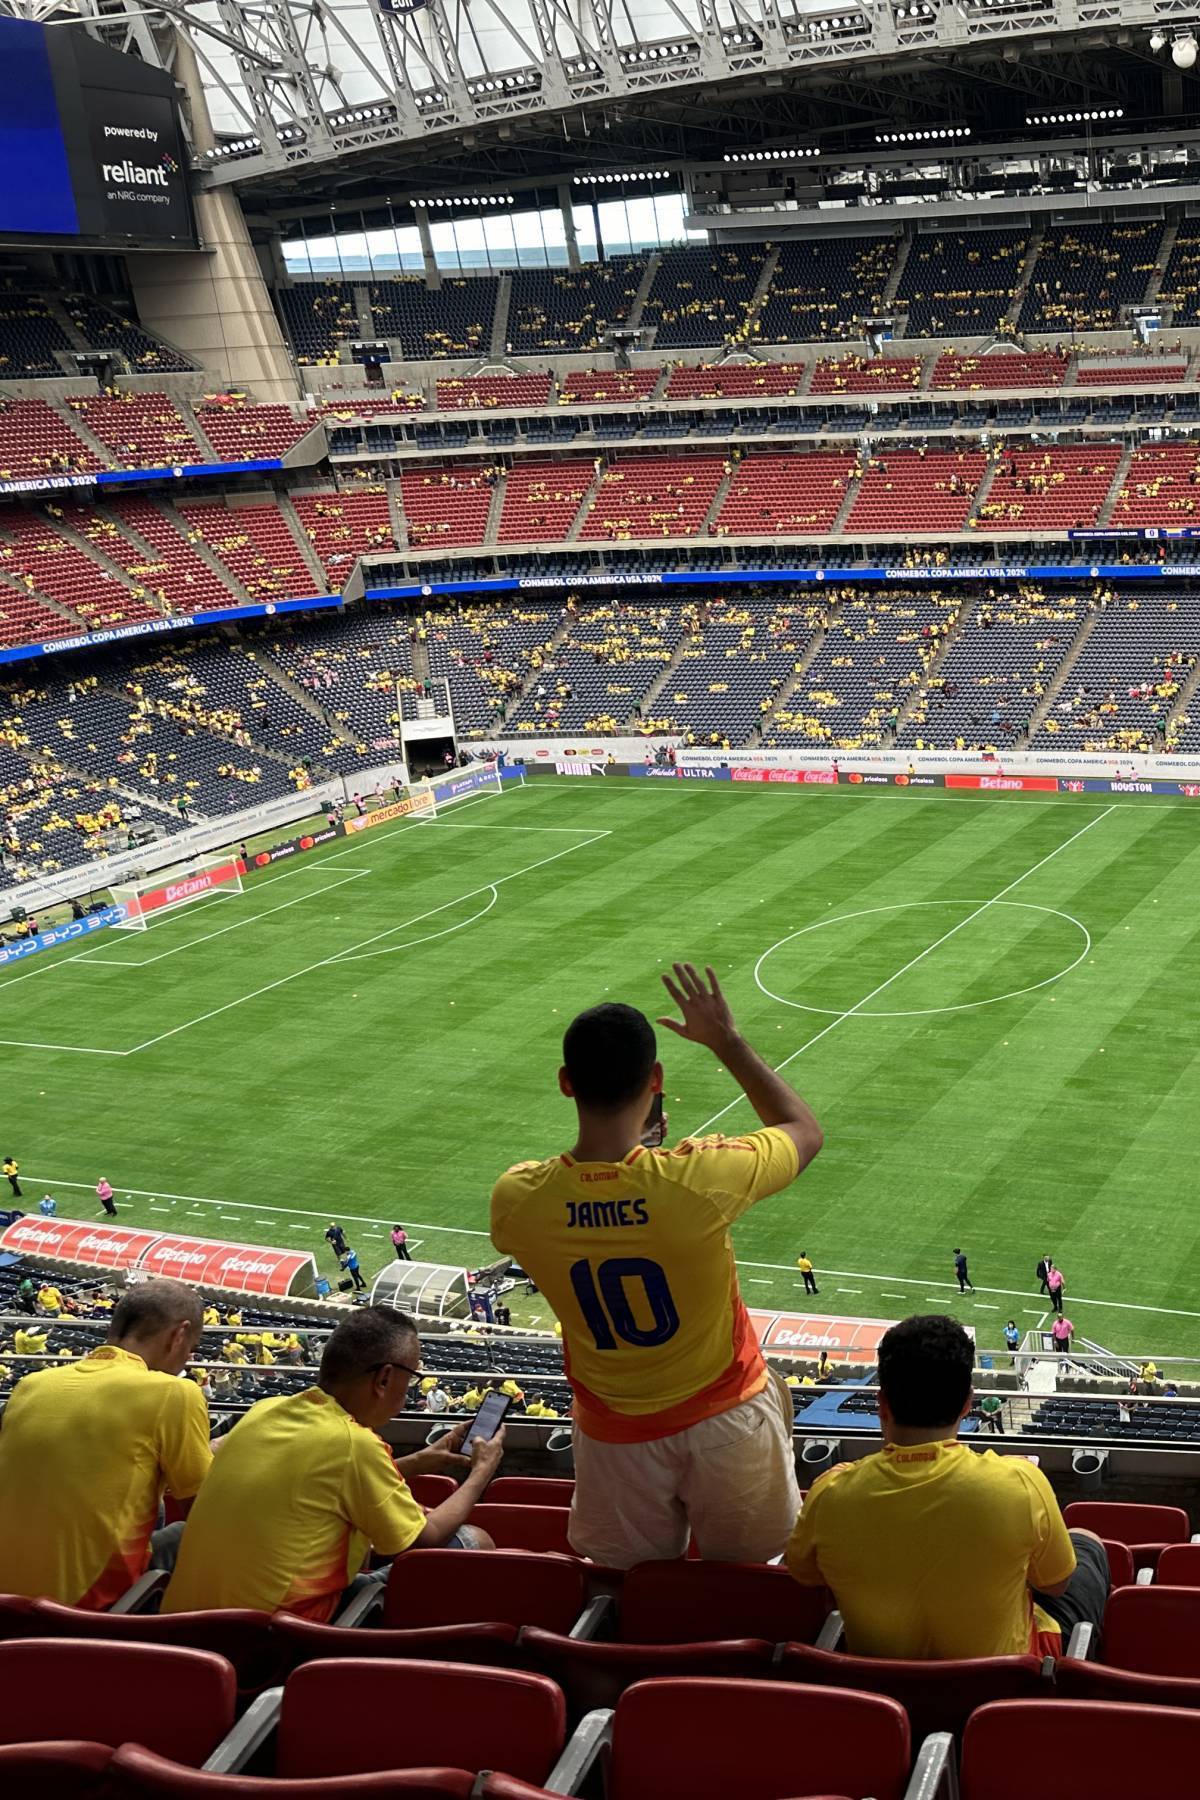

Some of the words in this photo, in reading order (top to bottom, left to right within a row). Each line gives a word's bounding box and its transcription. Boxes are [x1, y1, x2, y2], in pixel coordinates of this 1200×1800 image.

[103, 126, 146, 139] powered
[146, 128, 159, 142] by
[102, 160, 169, 186] reliant
[107, 191, 117, 200] an
[117, 190, 136, 201] NRG
[136, 193, 170, 205] company
[4, 479, 51, 493] AMERICA
[50, 476, 72, 488] USA
[519, 578, 565, 588] CONMEBOL
[565, 576, 588, 586] COPA
[588, 574, 626, 585] AMERICA
[625, 574, 643, 584] USA
[885, 569, 930, 579] CONMEBOL
[930, 569, 954, 578] COPA
[953, 569, 990, 578] AMERICA
[990, 568, 1007, 577] USA
[42, 636, 91, 653] CONMEBOL
[92, 631, 117, 644] COPA
[116, 623, 153, 639] AMERICA
[153, 620, 172, 632] USA
[555, 762, 592, 776] PUMA
[684, 768, 715, 779] ULTRA
[979, 776, 1023, 790] Betano
[1110, 782, 1153, 792] HOUSTON
[370, 802, 408, 824] mercado
[409, 794, 429, 810] libre
[271, 846, 295, 860] priceless
[166, 875, 211, 902] Betano
[41, 923, 83, 946] BYD
[566, 1197, 649, 1228] JAMES
[11, 1227, 62, 1244] Betano
[78, 1235, 128, 1253] Betano
[154, 1247, 207, 1265] Betano
[221, 1257, 275, 1275] Betano
[569, 1256, 680, 1350] 10
[775, 1329, 841, 1347] Betano
